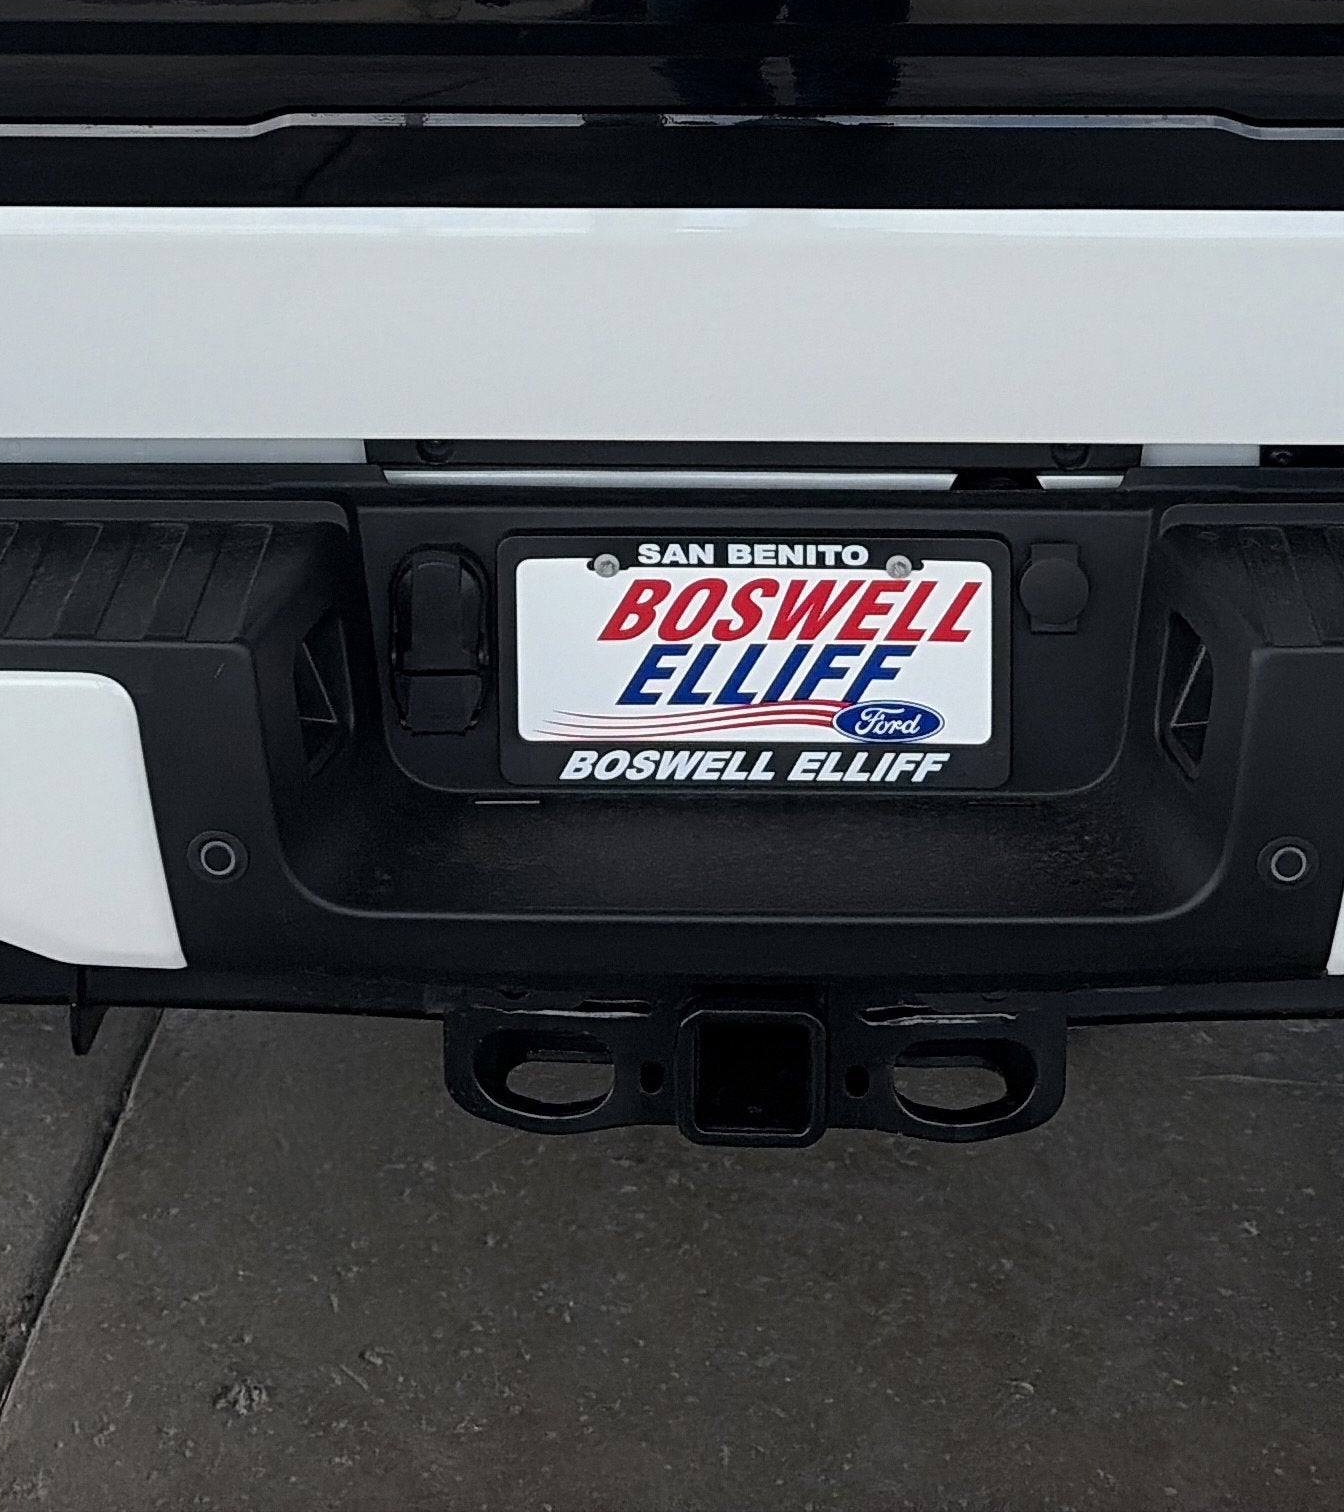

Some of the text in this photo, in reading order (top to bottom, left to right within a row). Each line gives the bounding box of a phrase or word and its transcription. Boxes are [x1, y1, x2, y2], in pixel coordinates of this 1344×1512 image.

[638, 543, 869, 566] SAN BENITO
[597, 578, 983, 642] BOSWELL
[615, 643, 919, 706] ELLIFF
[854, 708, 920, 736] Ford
[559, 749, 951, 783] BOSWELL ELLIFF
